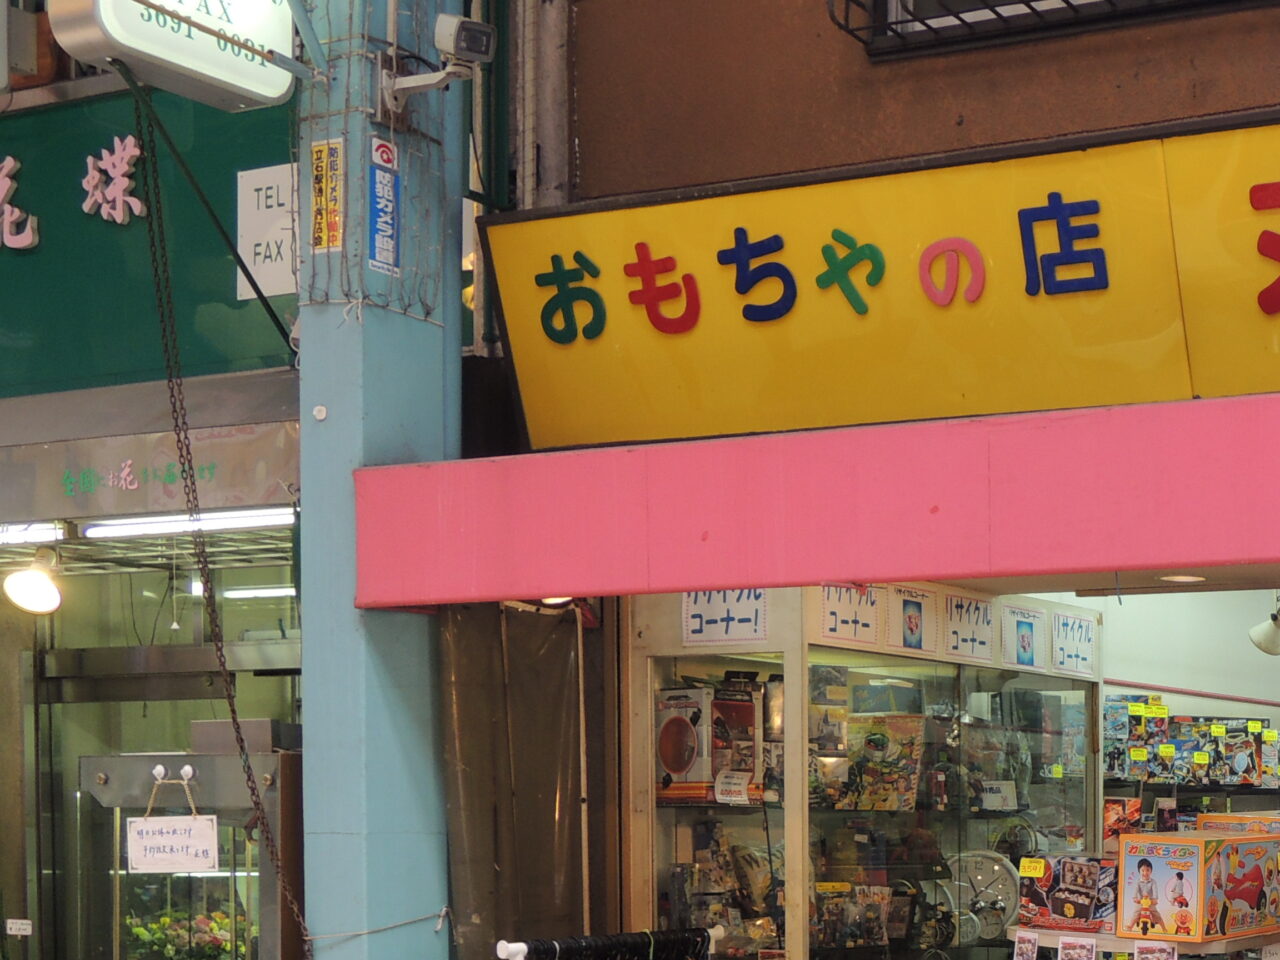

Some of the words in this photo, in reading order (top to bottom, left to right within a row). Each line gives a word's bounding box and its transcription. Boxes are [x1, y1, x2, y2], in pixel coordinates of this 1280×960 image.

[254, 186, 286, 210] TEL
[253, 239, 285, 265] FAX
[829, 611, 870, 637] コーナー
[945, 597, 992, 627] リサイクル
[952, 630, 987, 655] コーナー
[1053, 615, 1092, 644] リサイクル
[1059, 647, 1088, 670] コーナー
